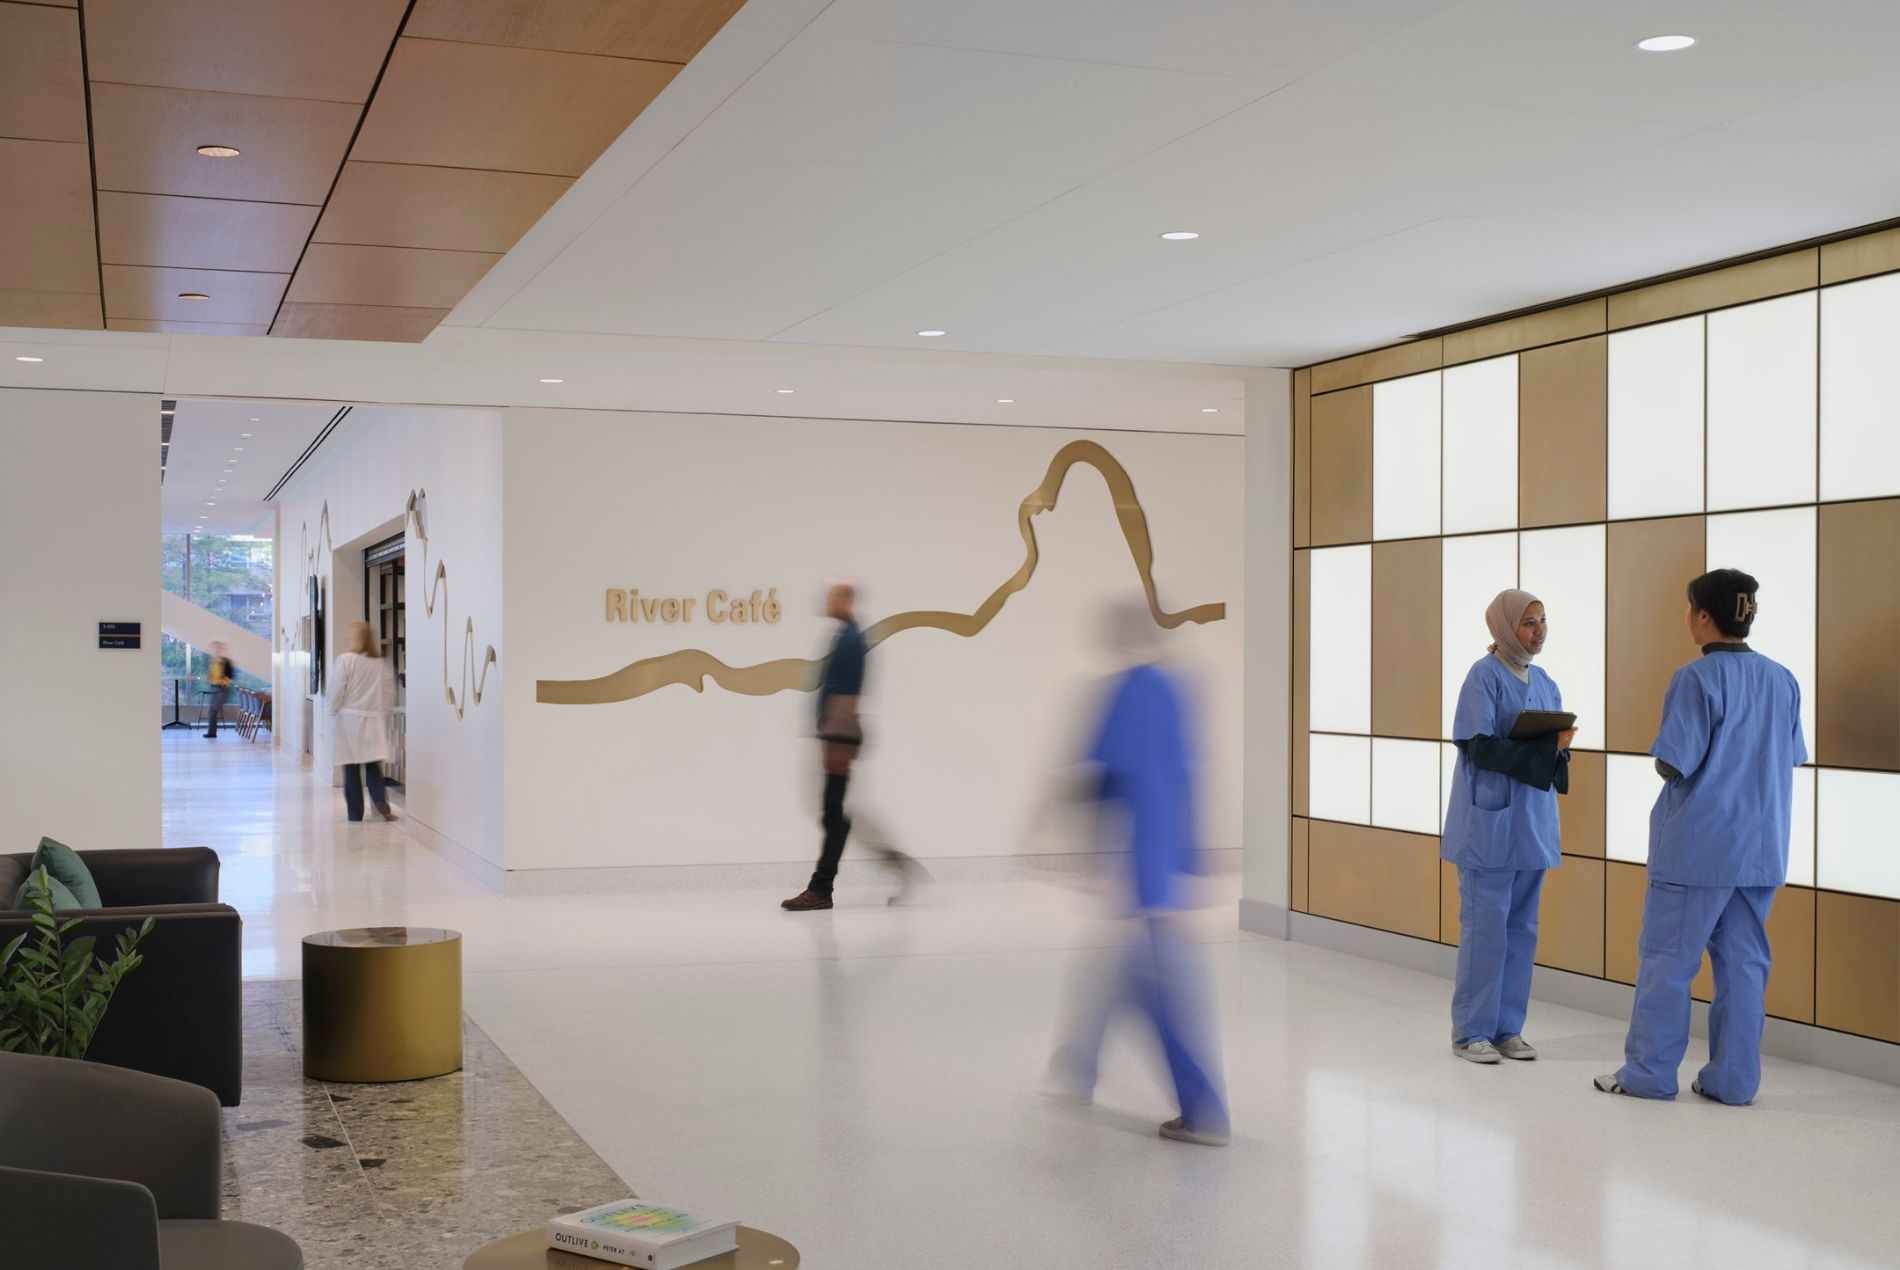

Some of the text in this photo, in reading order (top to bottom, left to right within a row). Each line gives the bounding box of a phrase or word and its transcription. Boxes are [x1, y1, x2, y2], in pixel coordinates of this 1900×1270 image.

[606, 587, 782, 624] River Café
[555, 1232, 589, 1248] OUTLIVE
[602, 1244, 617, 1254] PETER
